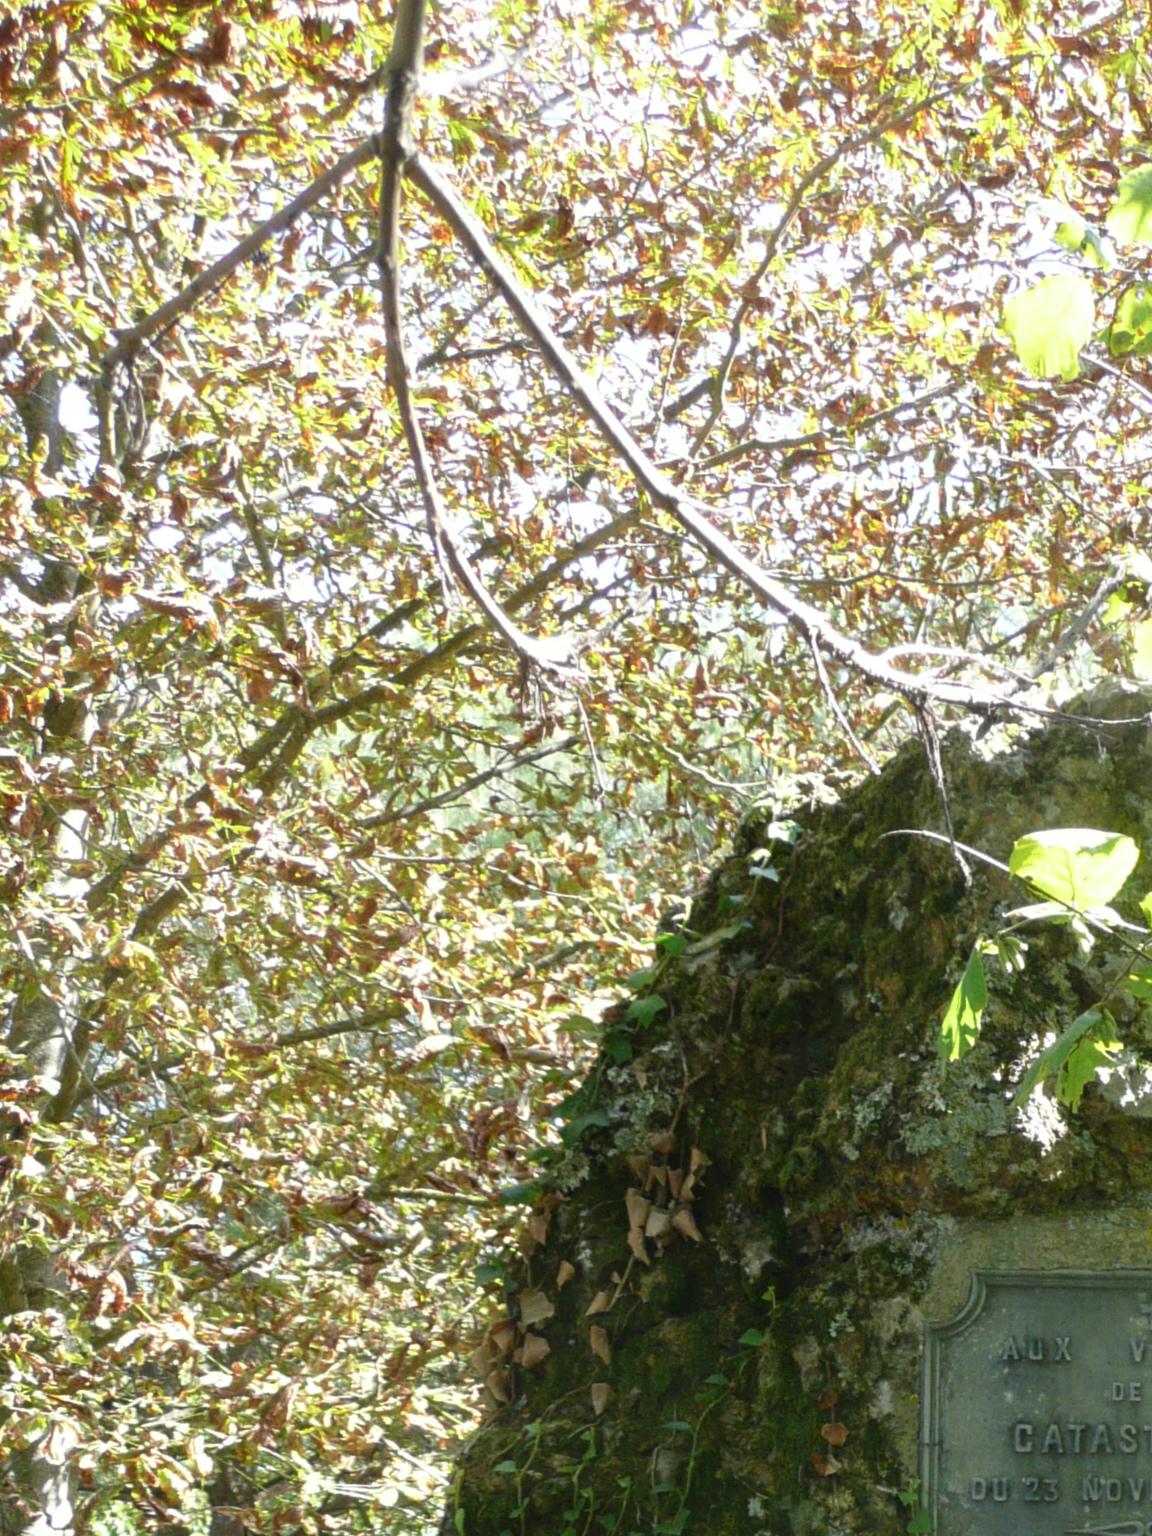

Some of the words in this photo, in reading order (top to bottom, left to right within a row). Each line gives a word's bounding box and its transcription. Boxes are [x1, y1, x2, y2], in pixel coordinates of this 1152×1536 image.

[1001, 1336, 1073, 1362] AUX
[1110, 1381, 1142, 1402] DE
[971, 1476, 1010, 1502] DU
[1023, 1477, 1060, 1502] 23
